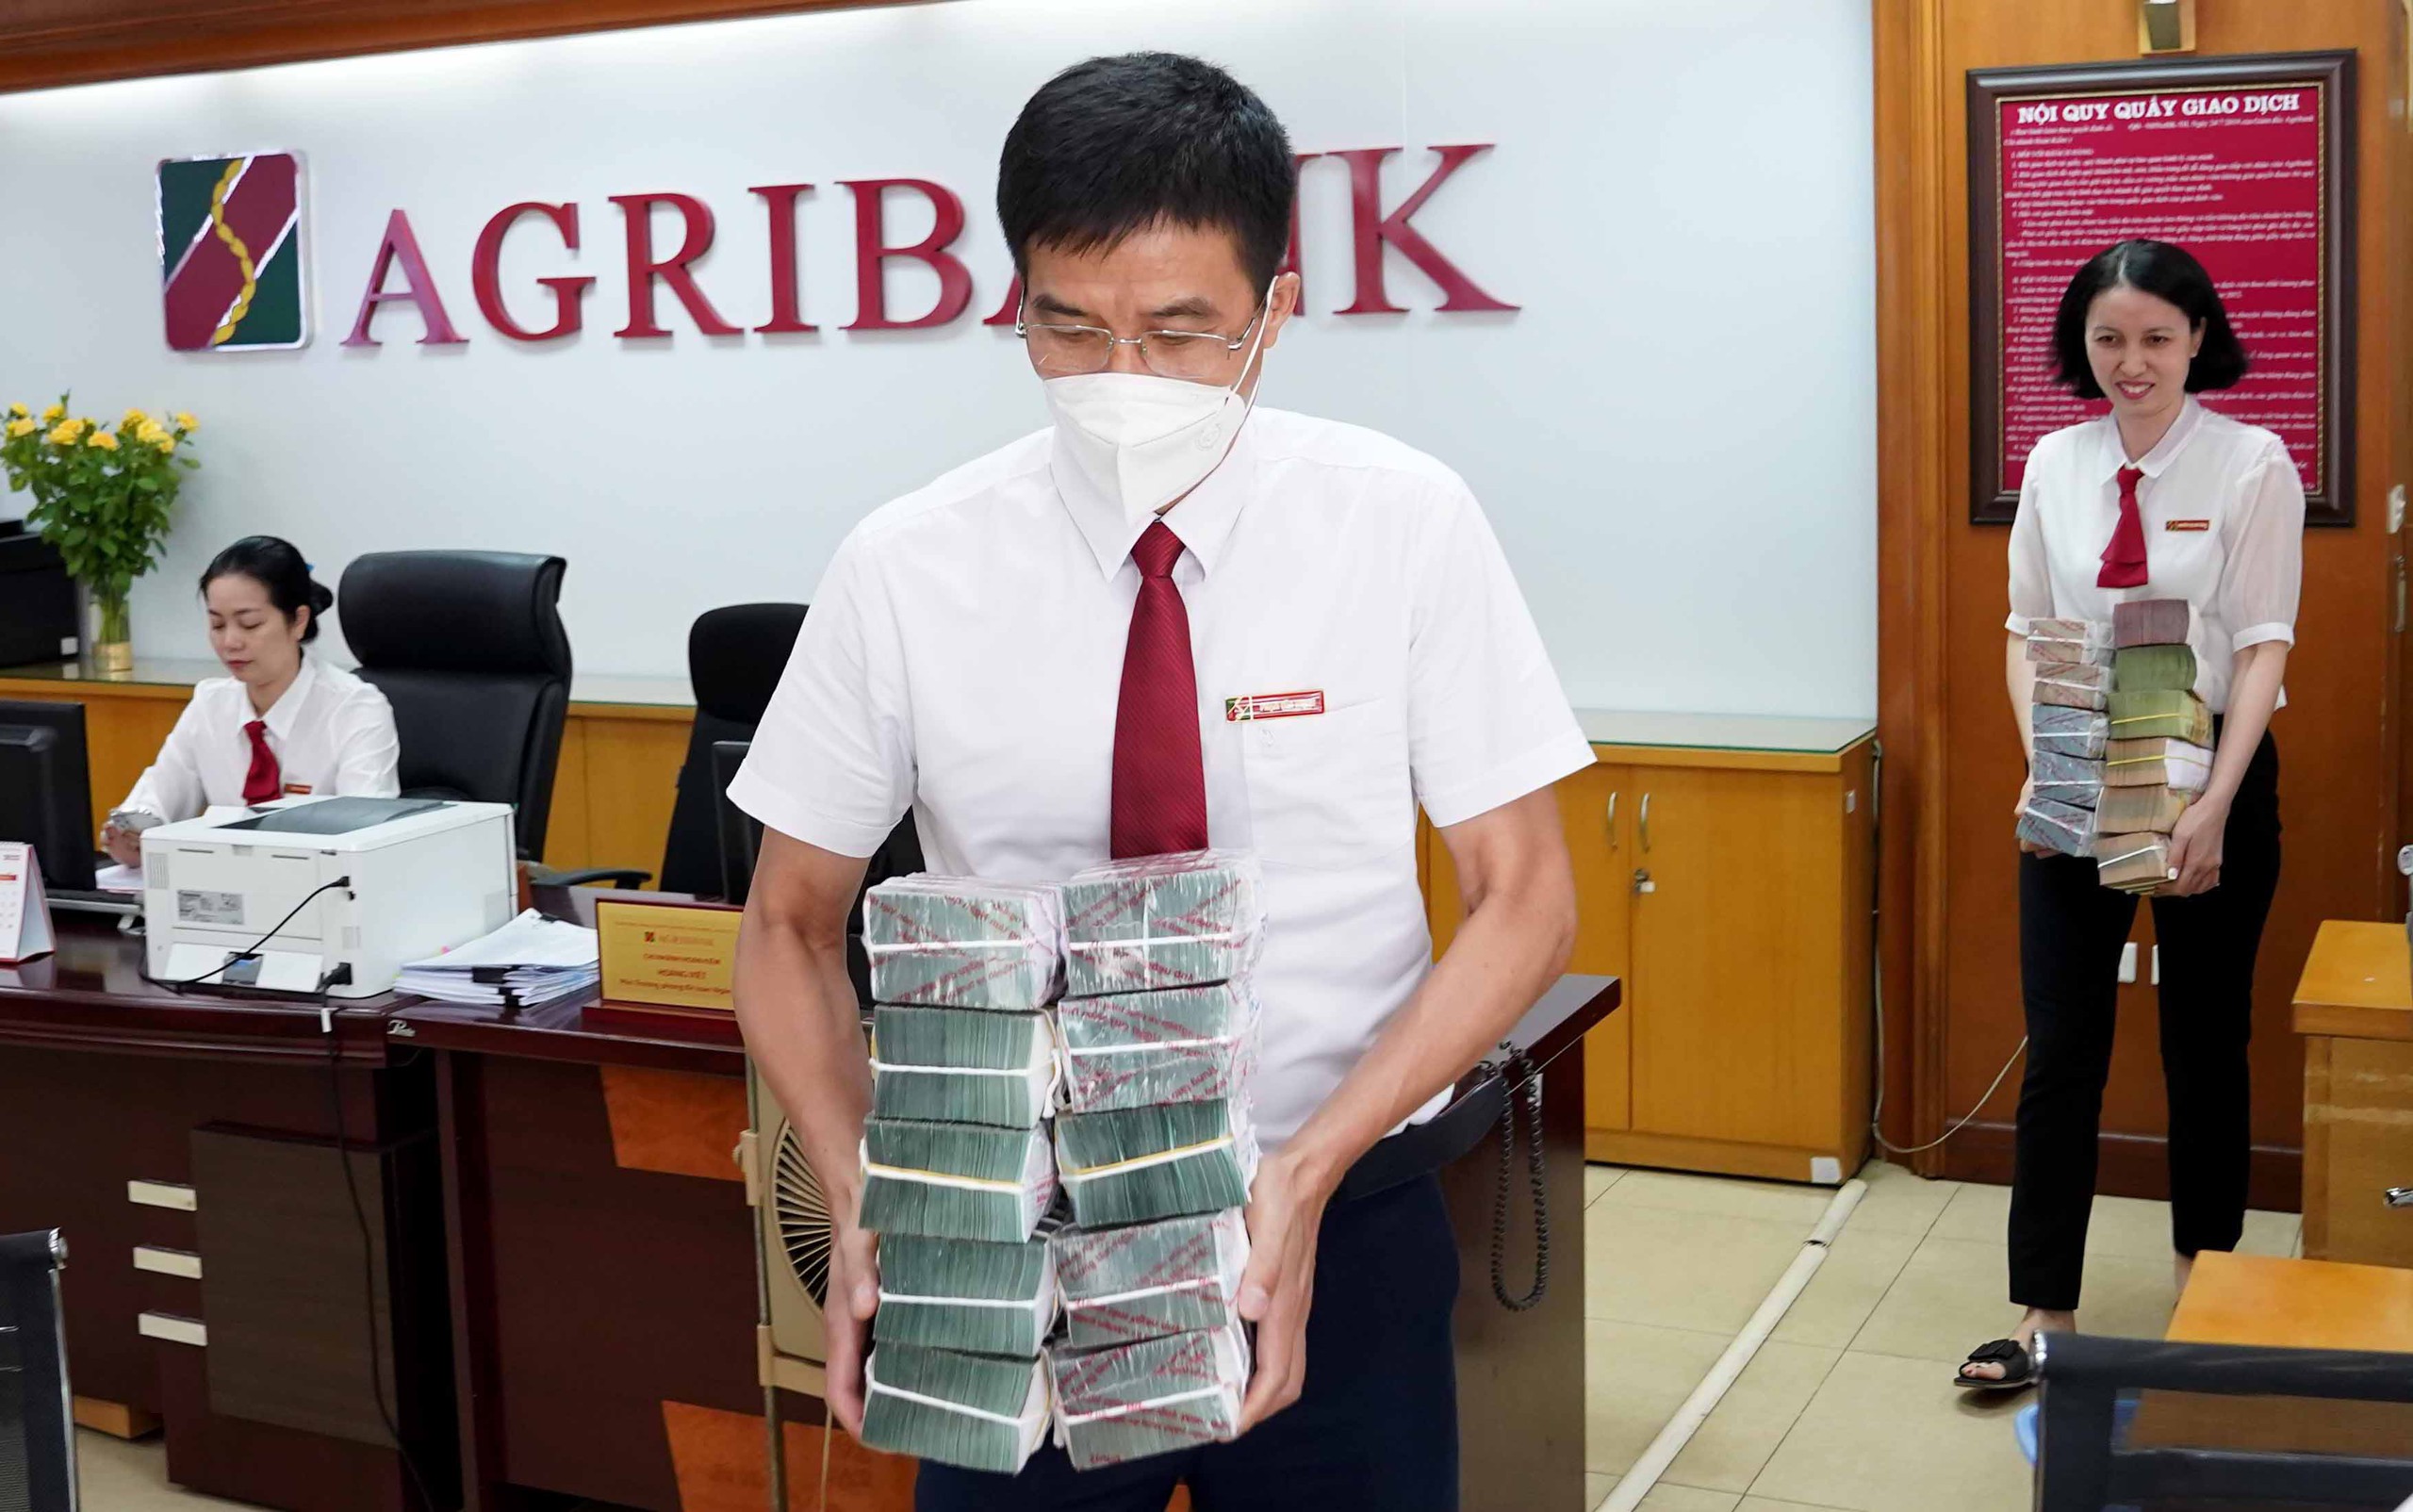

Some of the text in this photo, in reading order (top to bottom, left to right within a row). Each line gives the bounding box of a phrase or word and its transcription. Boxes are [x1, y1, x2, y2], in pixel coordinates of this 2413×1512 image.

[2017, 102, 2059, 125] NỘI
[2062, 103, 2110, 122] QUY
[2181, 96, 2240, 116] GIAO
[2243, 93, 2301, 116] DỊCH
[339, 143, 1521, 346] AGRIBK
